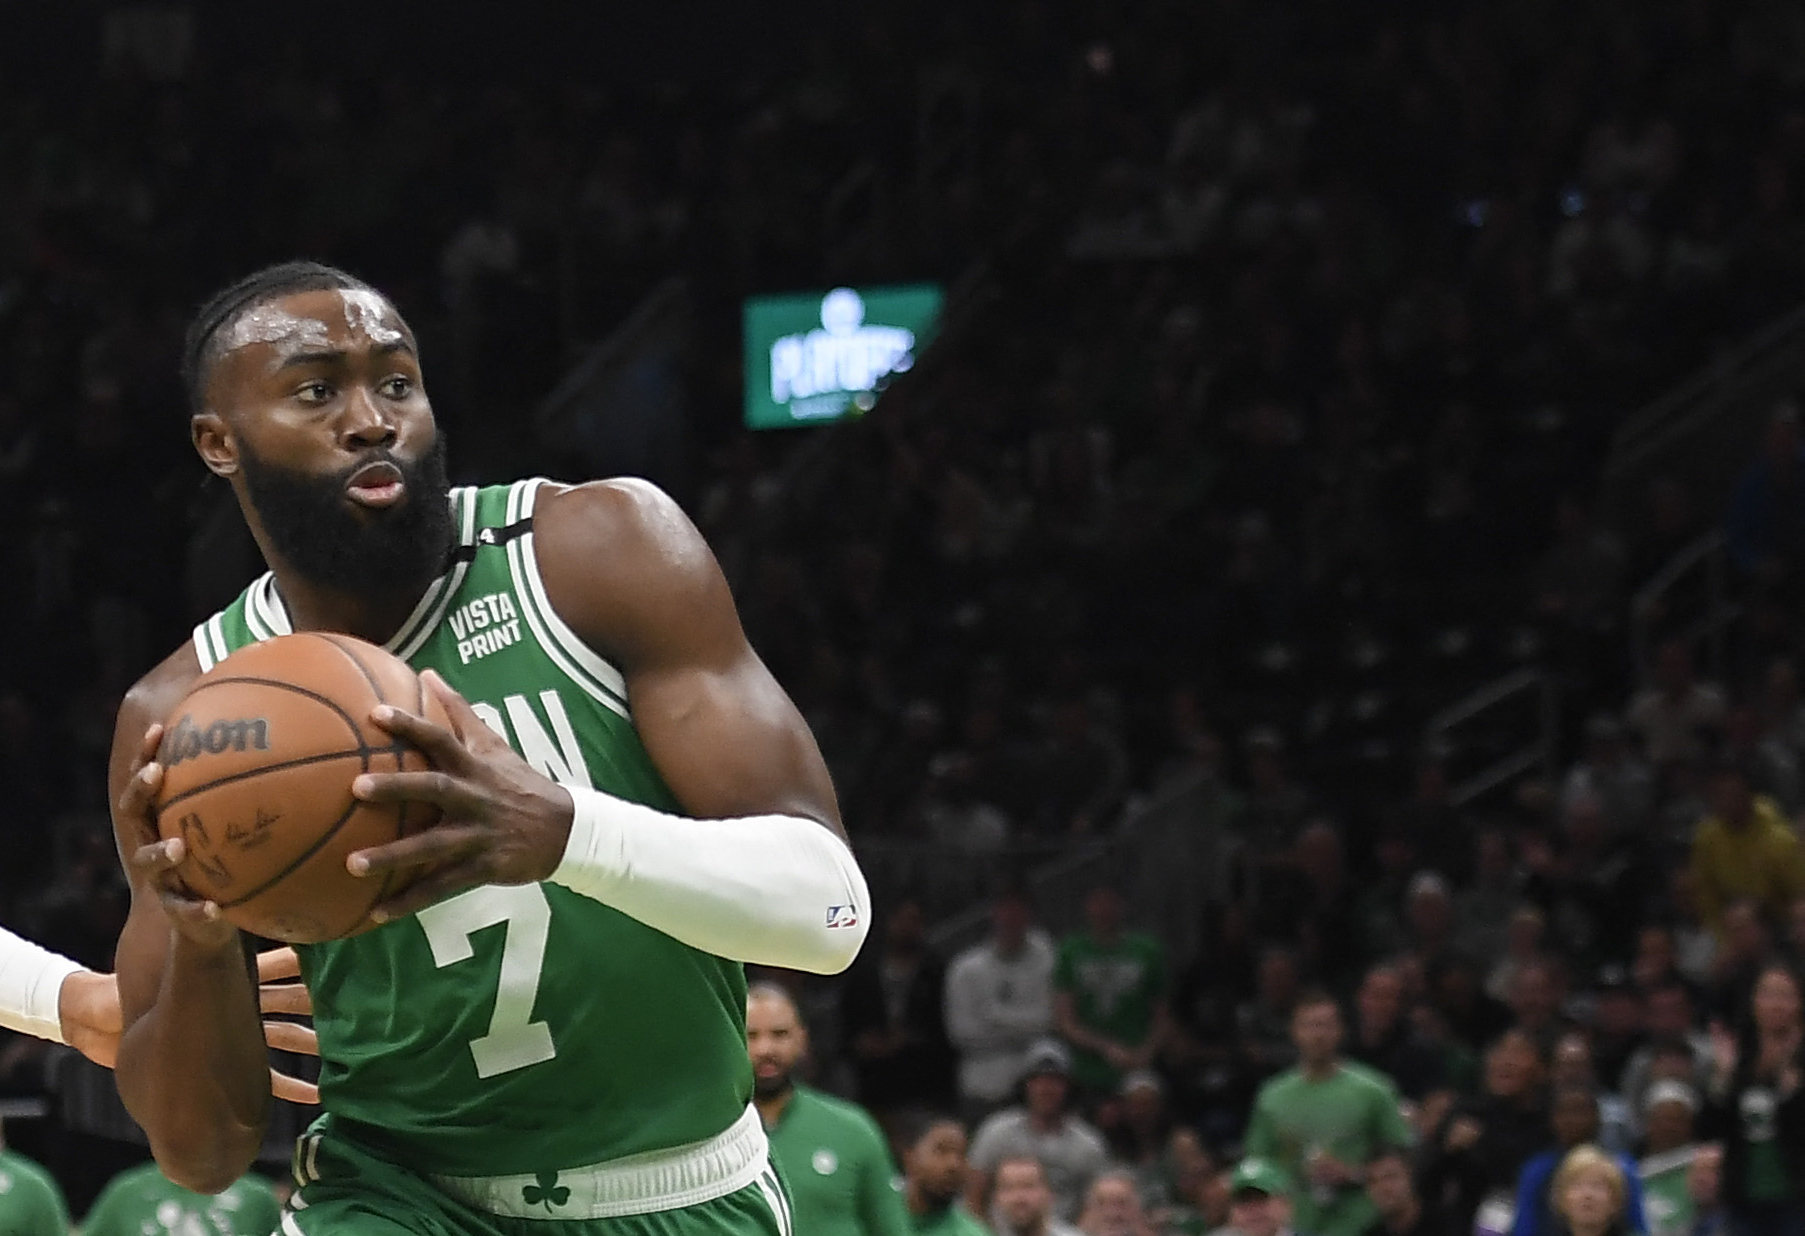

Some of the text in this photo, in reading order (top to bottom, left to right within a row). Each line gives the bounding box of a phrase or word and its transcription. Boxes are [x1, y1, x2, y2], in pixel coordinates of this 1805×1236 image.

[448, 592, 518, 641] VISTA
[457, 619, 522, 665] PRINT
[415, 881, 557, 1080] 7
